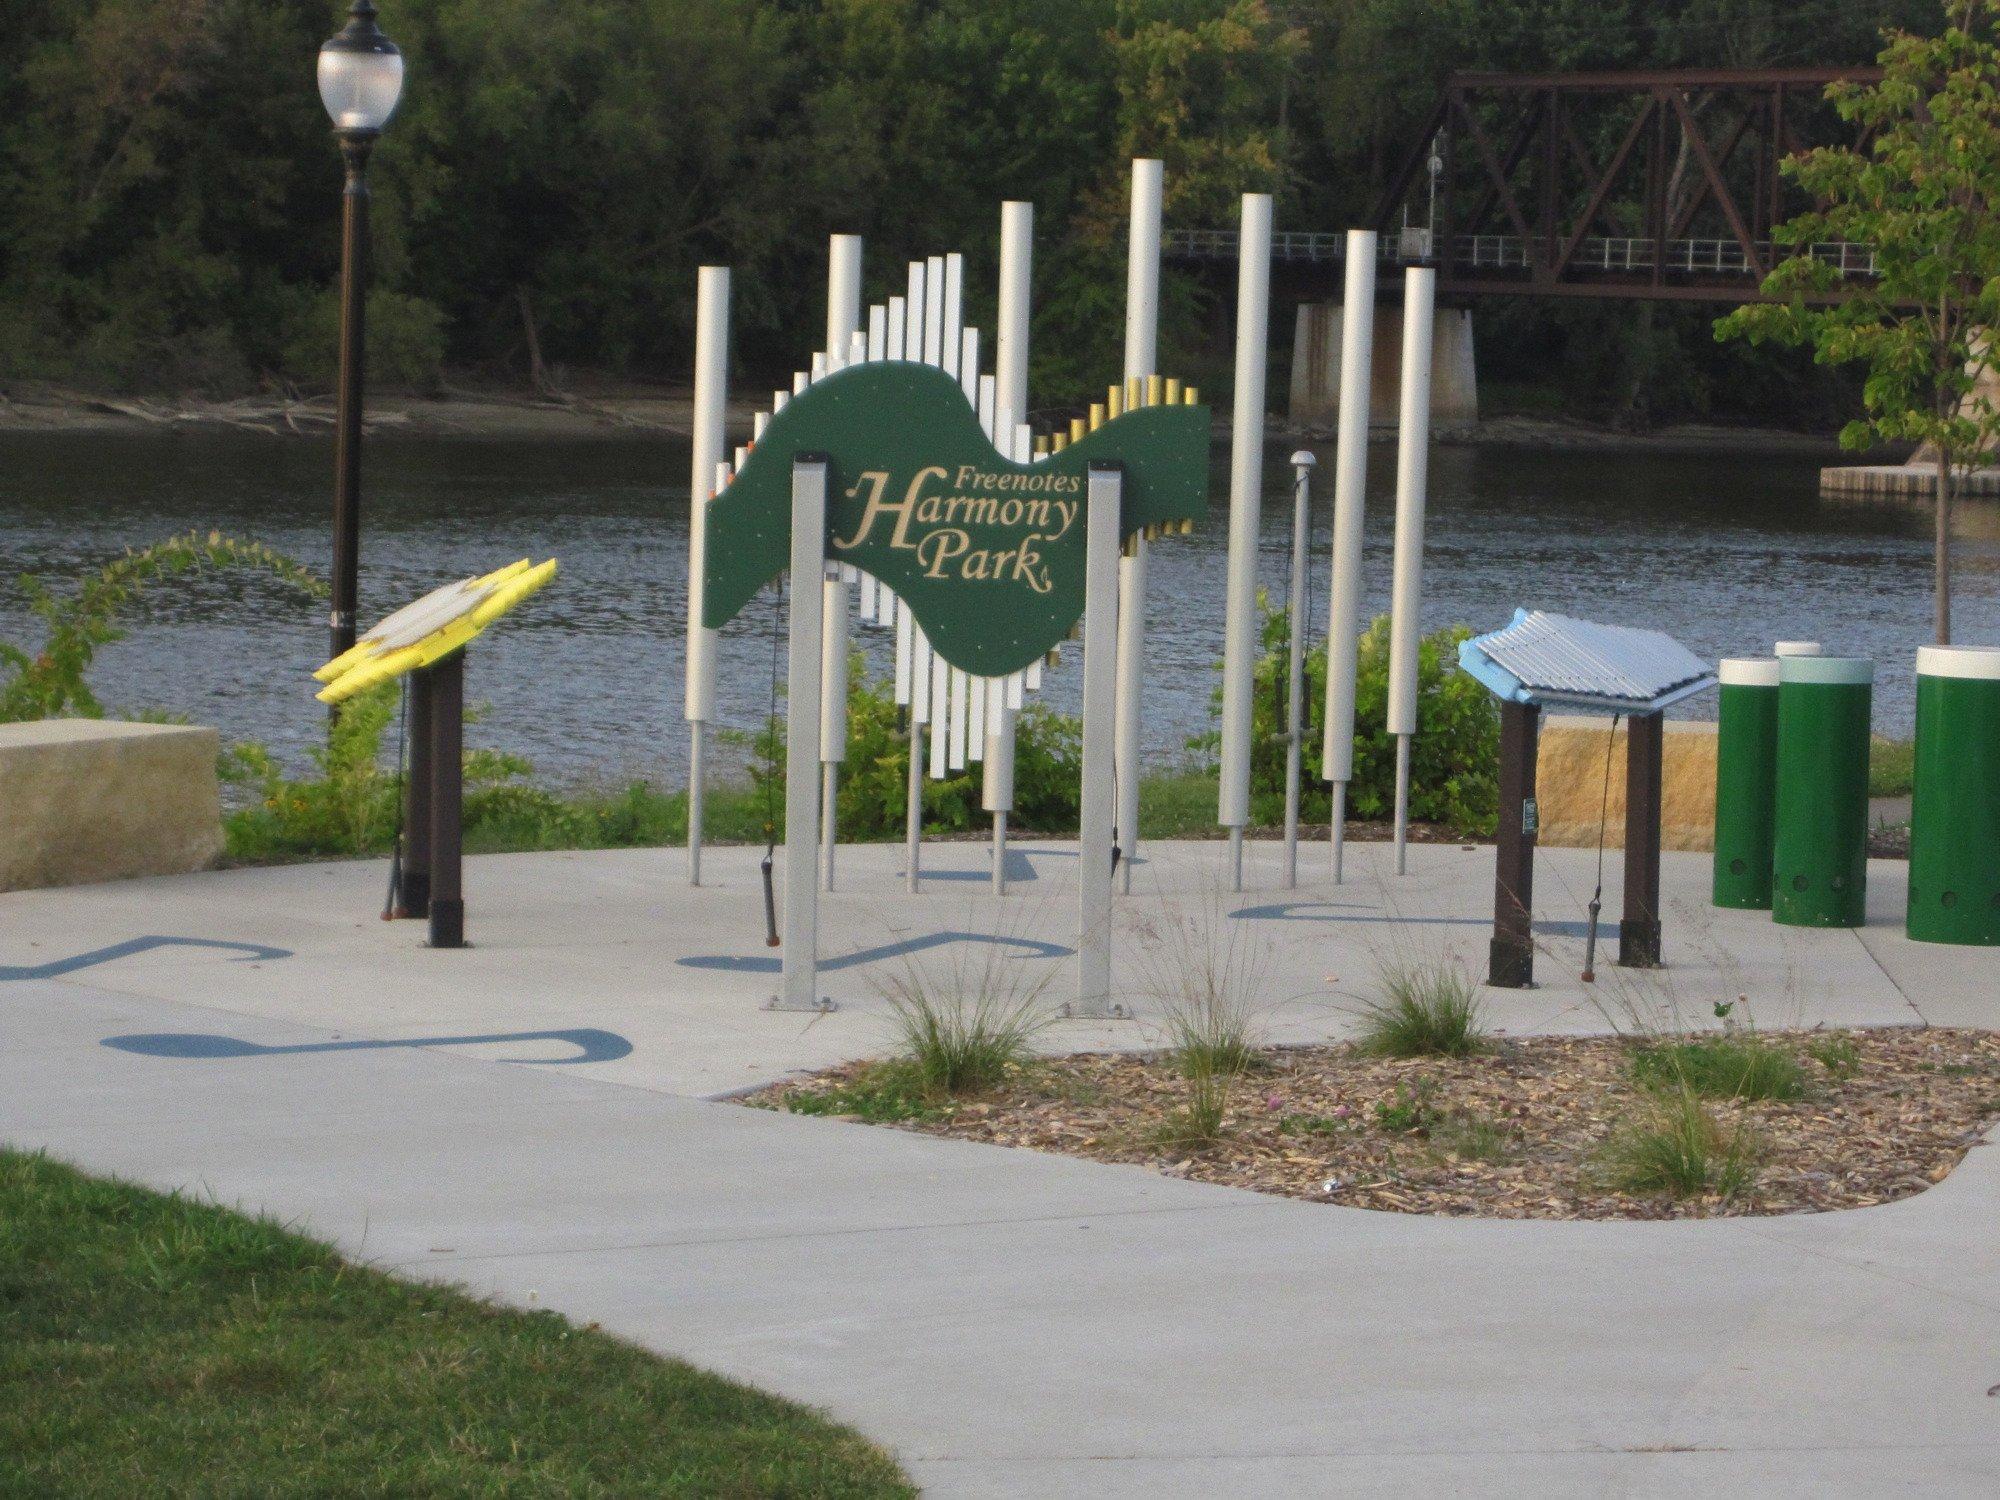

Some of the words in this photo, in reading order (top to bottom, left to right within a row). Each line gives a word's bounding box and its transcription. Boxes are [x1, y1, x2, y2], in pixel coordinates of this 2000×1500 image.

[833, 467, 1079, 549] Harmony
[955, 466, 1080, 493] Freenotes
[917, 528, 1052, 593] Park
